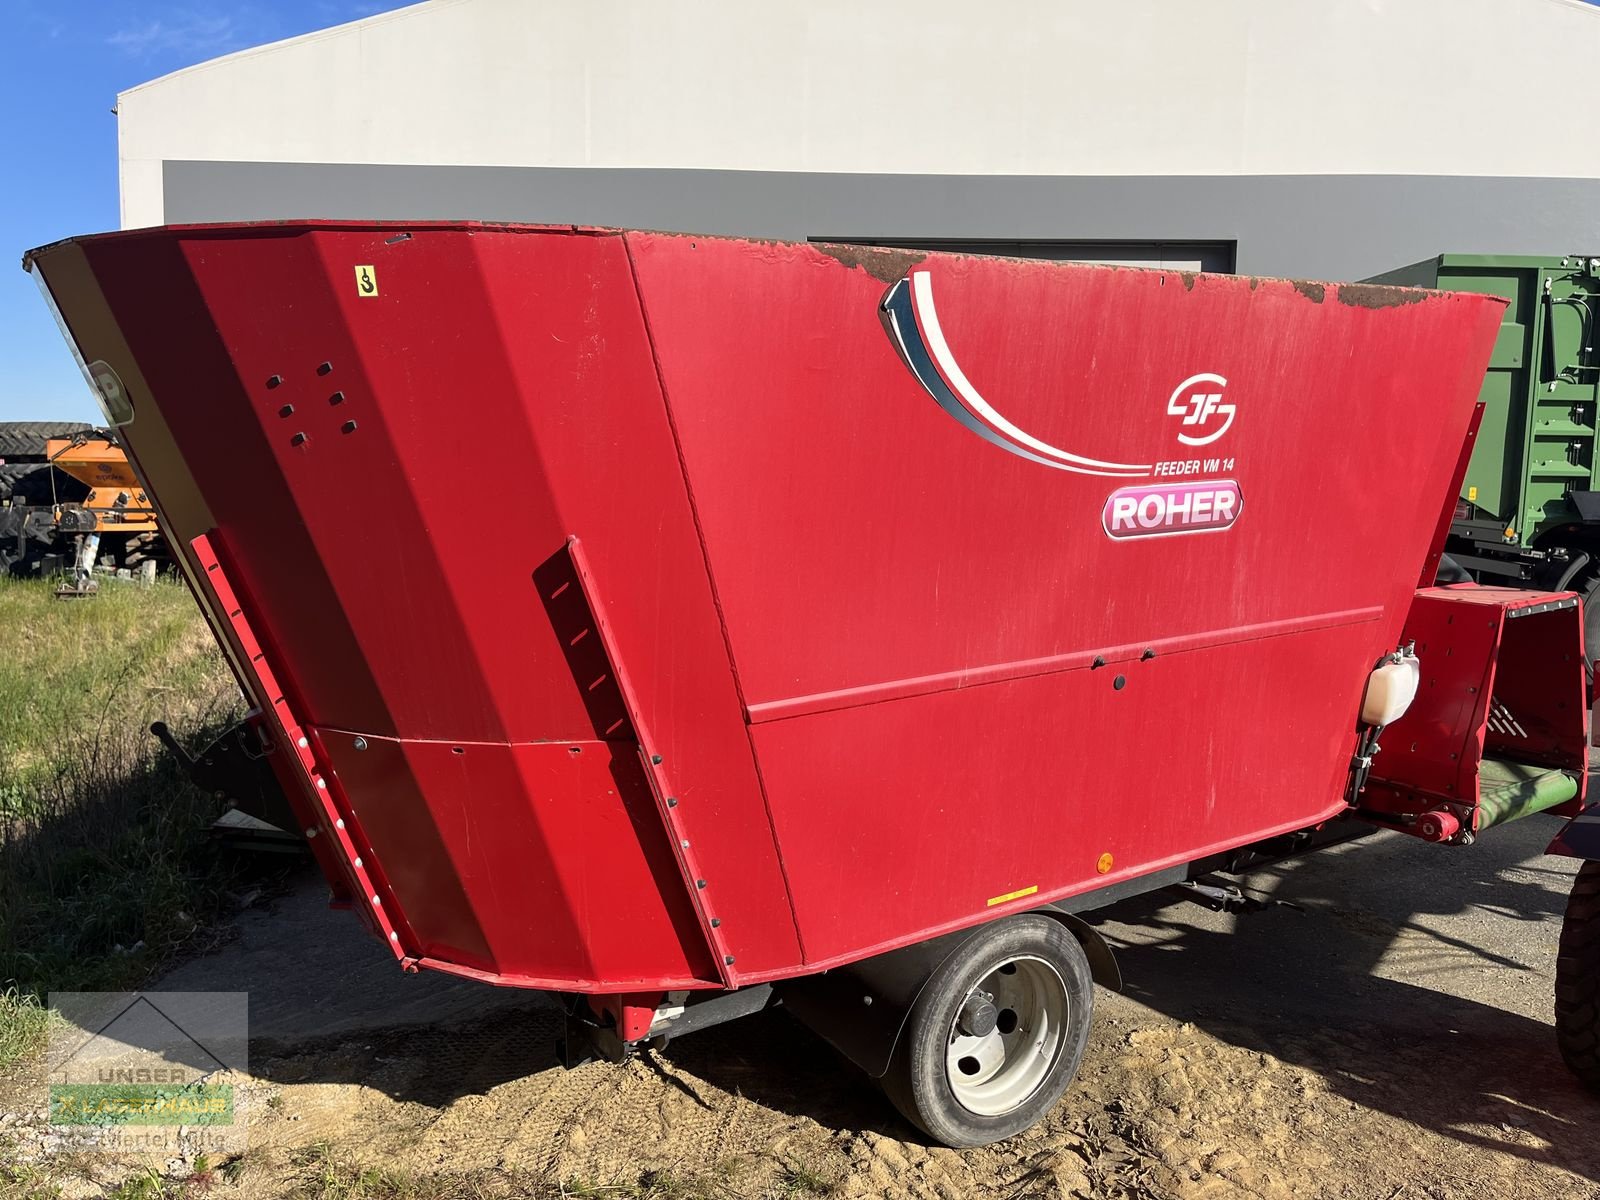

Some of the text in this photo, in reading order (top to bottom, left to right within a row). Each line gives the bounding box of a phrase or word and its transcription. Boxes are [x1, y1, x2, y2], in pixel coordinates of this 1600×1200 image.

[1154, 457, 1235, 477] FEEDER VM 14
[1111, 490, 1236, 530] ROHER
